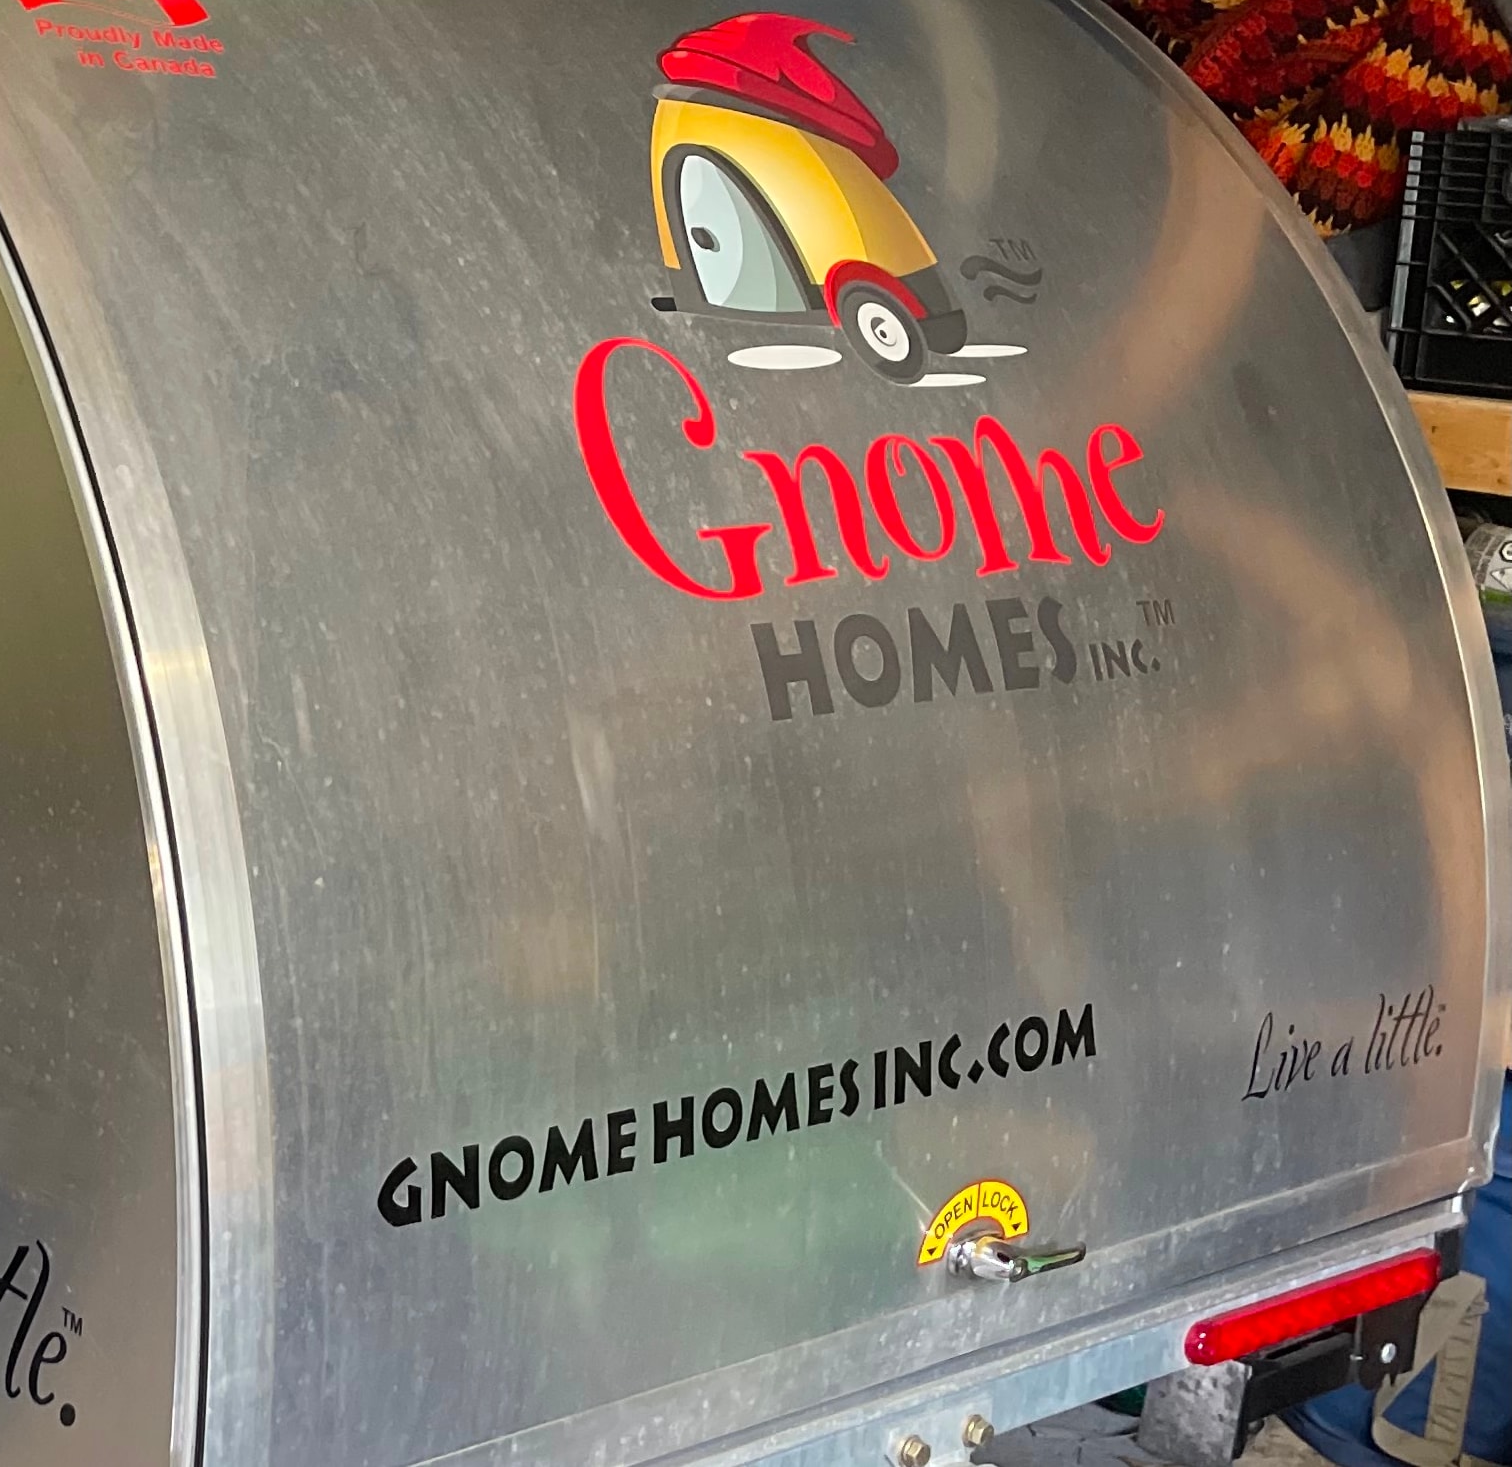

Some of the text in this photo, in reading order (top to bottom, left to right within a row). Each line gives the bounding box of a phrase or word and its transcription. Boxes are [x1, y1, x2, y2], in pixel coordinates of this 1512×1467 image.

[34, 17, 224, 53] Proudly Made
[78, 48, 217, 78] in Canada
[991, 238, 1035, 262] TM
[573, 337, 1165, 601] Gnome
[750, 596, 1078, 721] HOMES
[1089, 637, 1162, 682] INC.
[1241, 1012, 1321, 1101] Live
[1331, 1036, 1354, 1077] a
[935, 1191, 1019, 1240] OPEN LOCK
